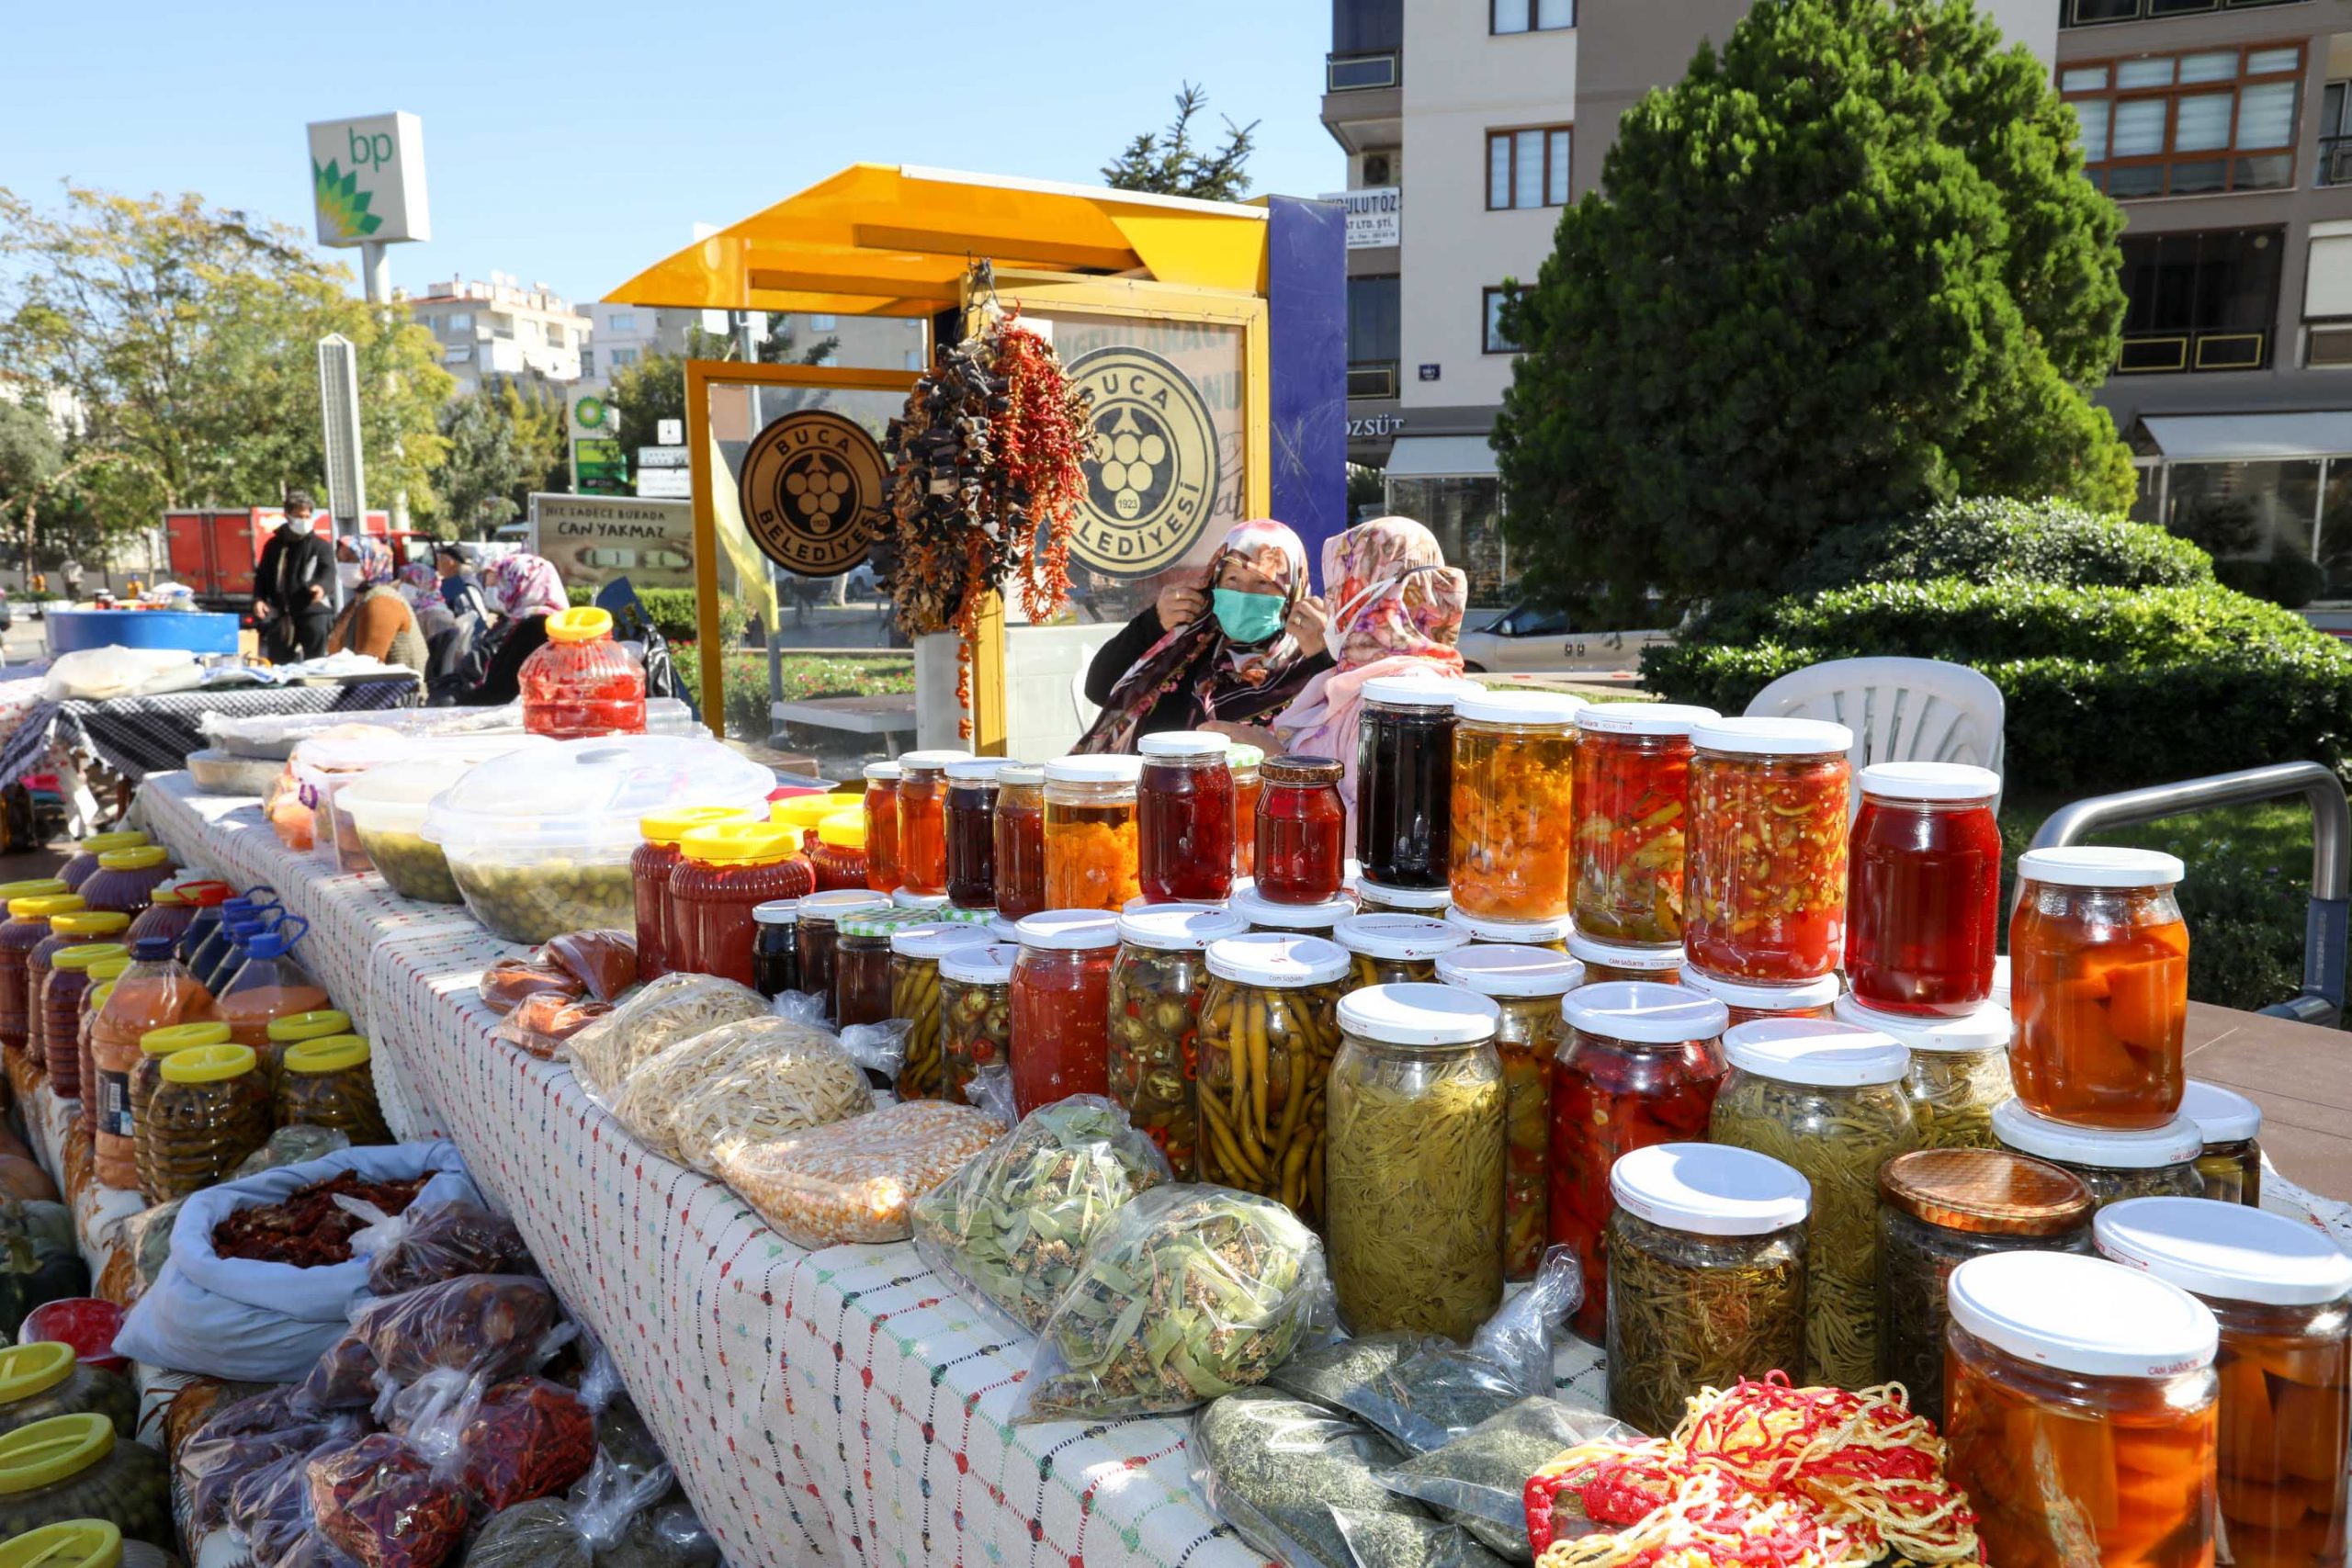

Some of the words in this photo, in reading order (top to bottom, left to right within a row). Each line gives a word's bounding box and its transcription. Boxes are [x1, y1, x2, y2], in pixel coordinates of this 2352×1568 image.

[348, 126, 393, 173] bp
[775, 429, 850, 456] BUCA
[1118, 498, 1137, 509] 1923
[570, 507, 613, 519] SADECE
[618, 509, 665, 520] BURADA
[1073, 481, 1200, 557] LEDİYESİ
[558, 521, 594, 536] CAN
[597, 522, 665, 538] YAKMAZ
[2147, 1366, 2166, 1376] CAM
